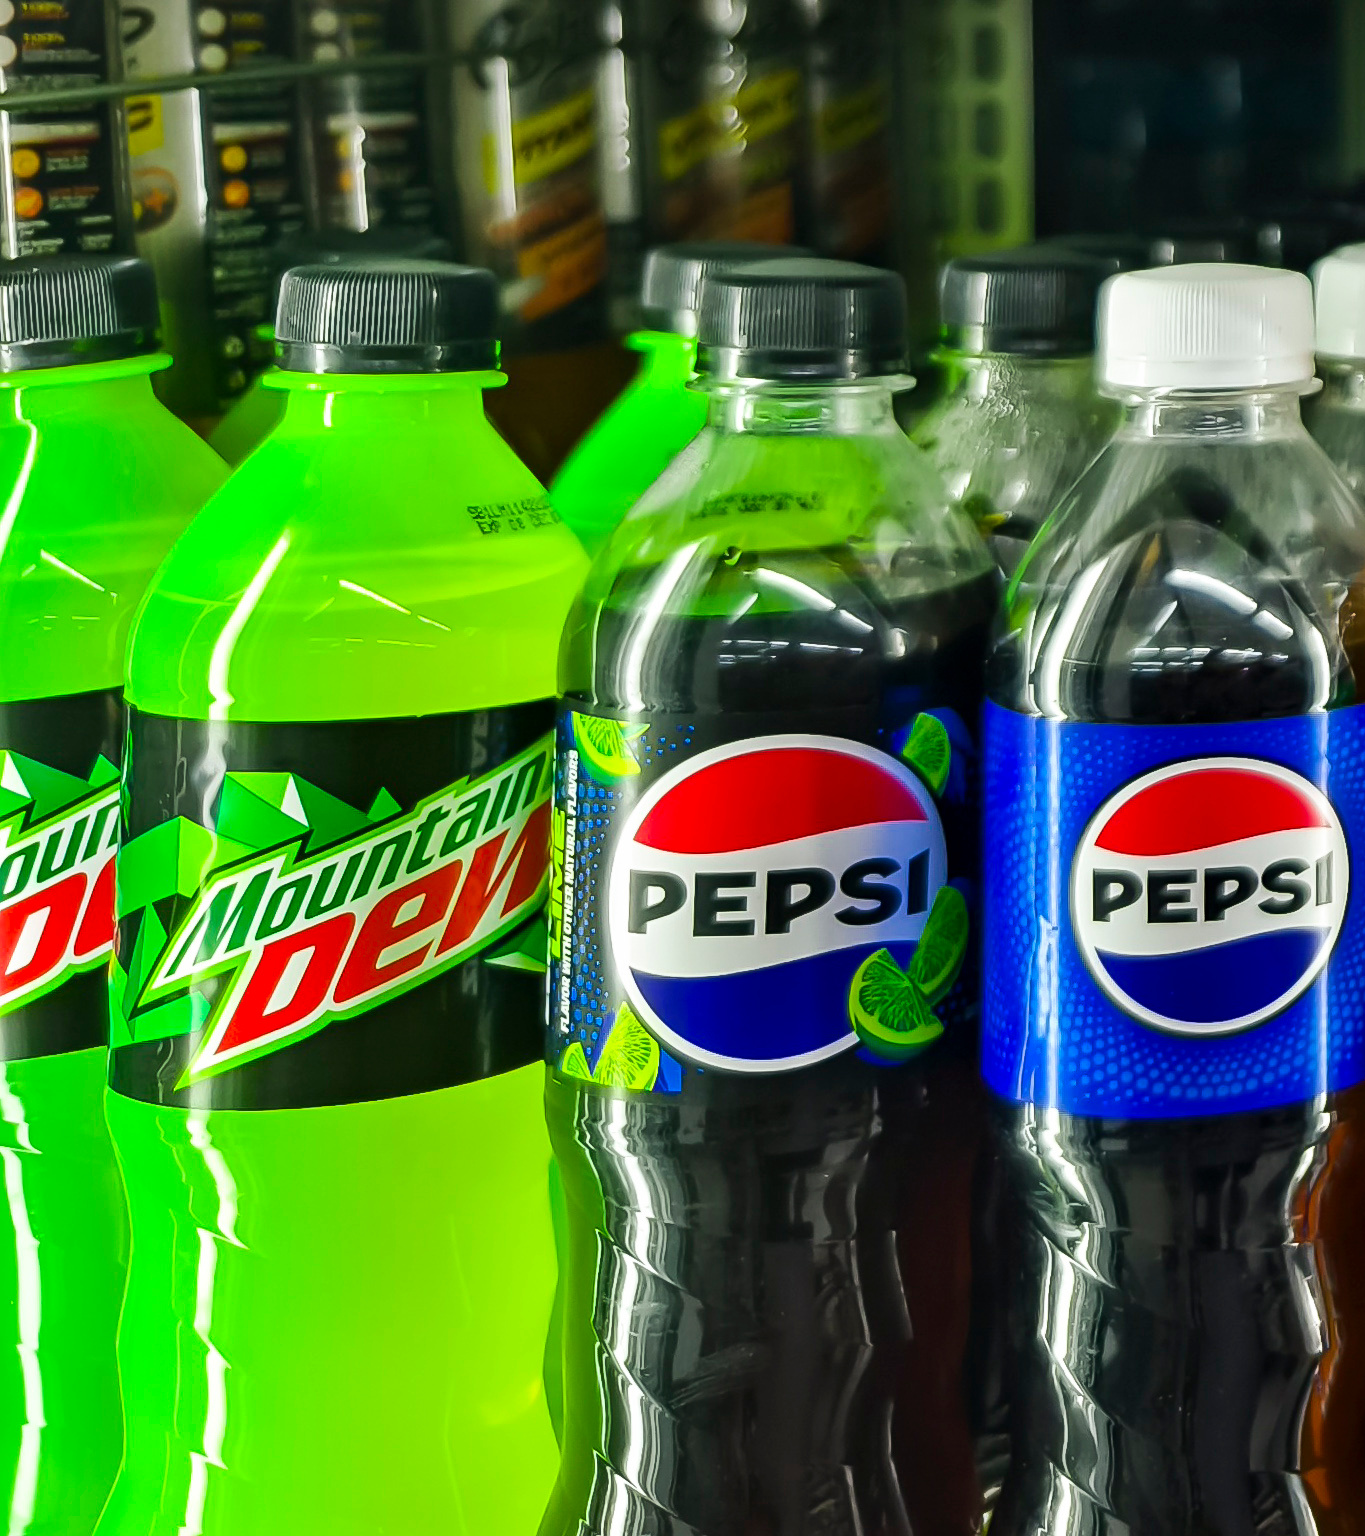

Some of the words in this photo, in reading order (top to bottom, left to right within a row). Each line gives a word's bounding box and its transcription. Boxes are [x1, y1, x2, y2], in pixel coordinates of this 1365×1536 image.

[567, 750, 579, 816] FLAVORS
[164, 748, 548, 976] Mountain
[551, 807, 565, 957] LIME
[565, 817, 577, 884] NATURAL
[563, 887, 574, 935] OTHER
[628, 849, 930, 937] PEPSI
[1093, 851, 1333, 923] PEPSI
[562, 937, 571, 969] WITH
[560, 971, 571, 1033] FLAVOR
